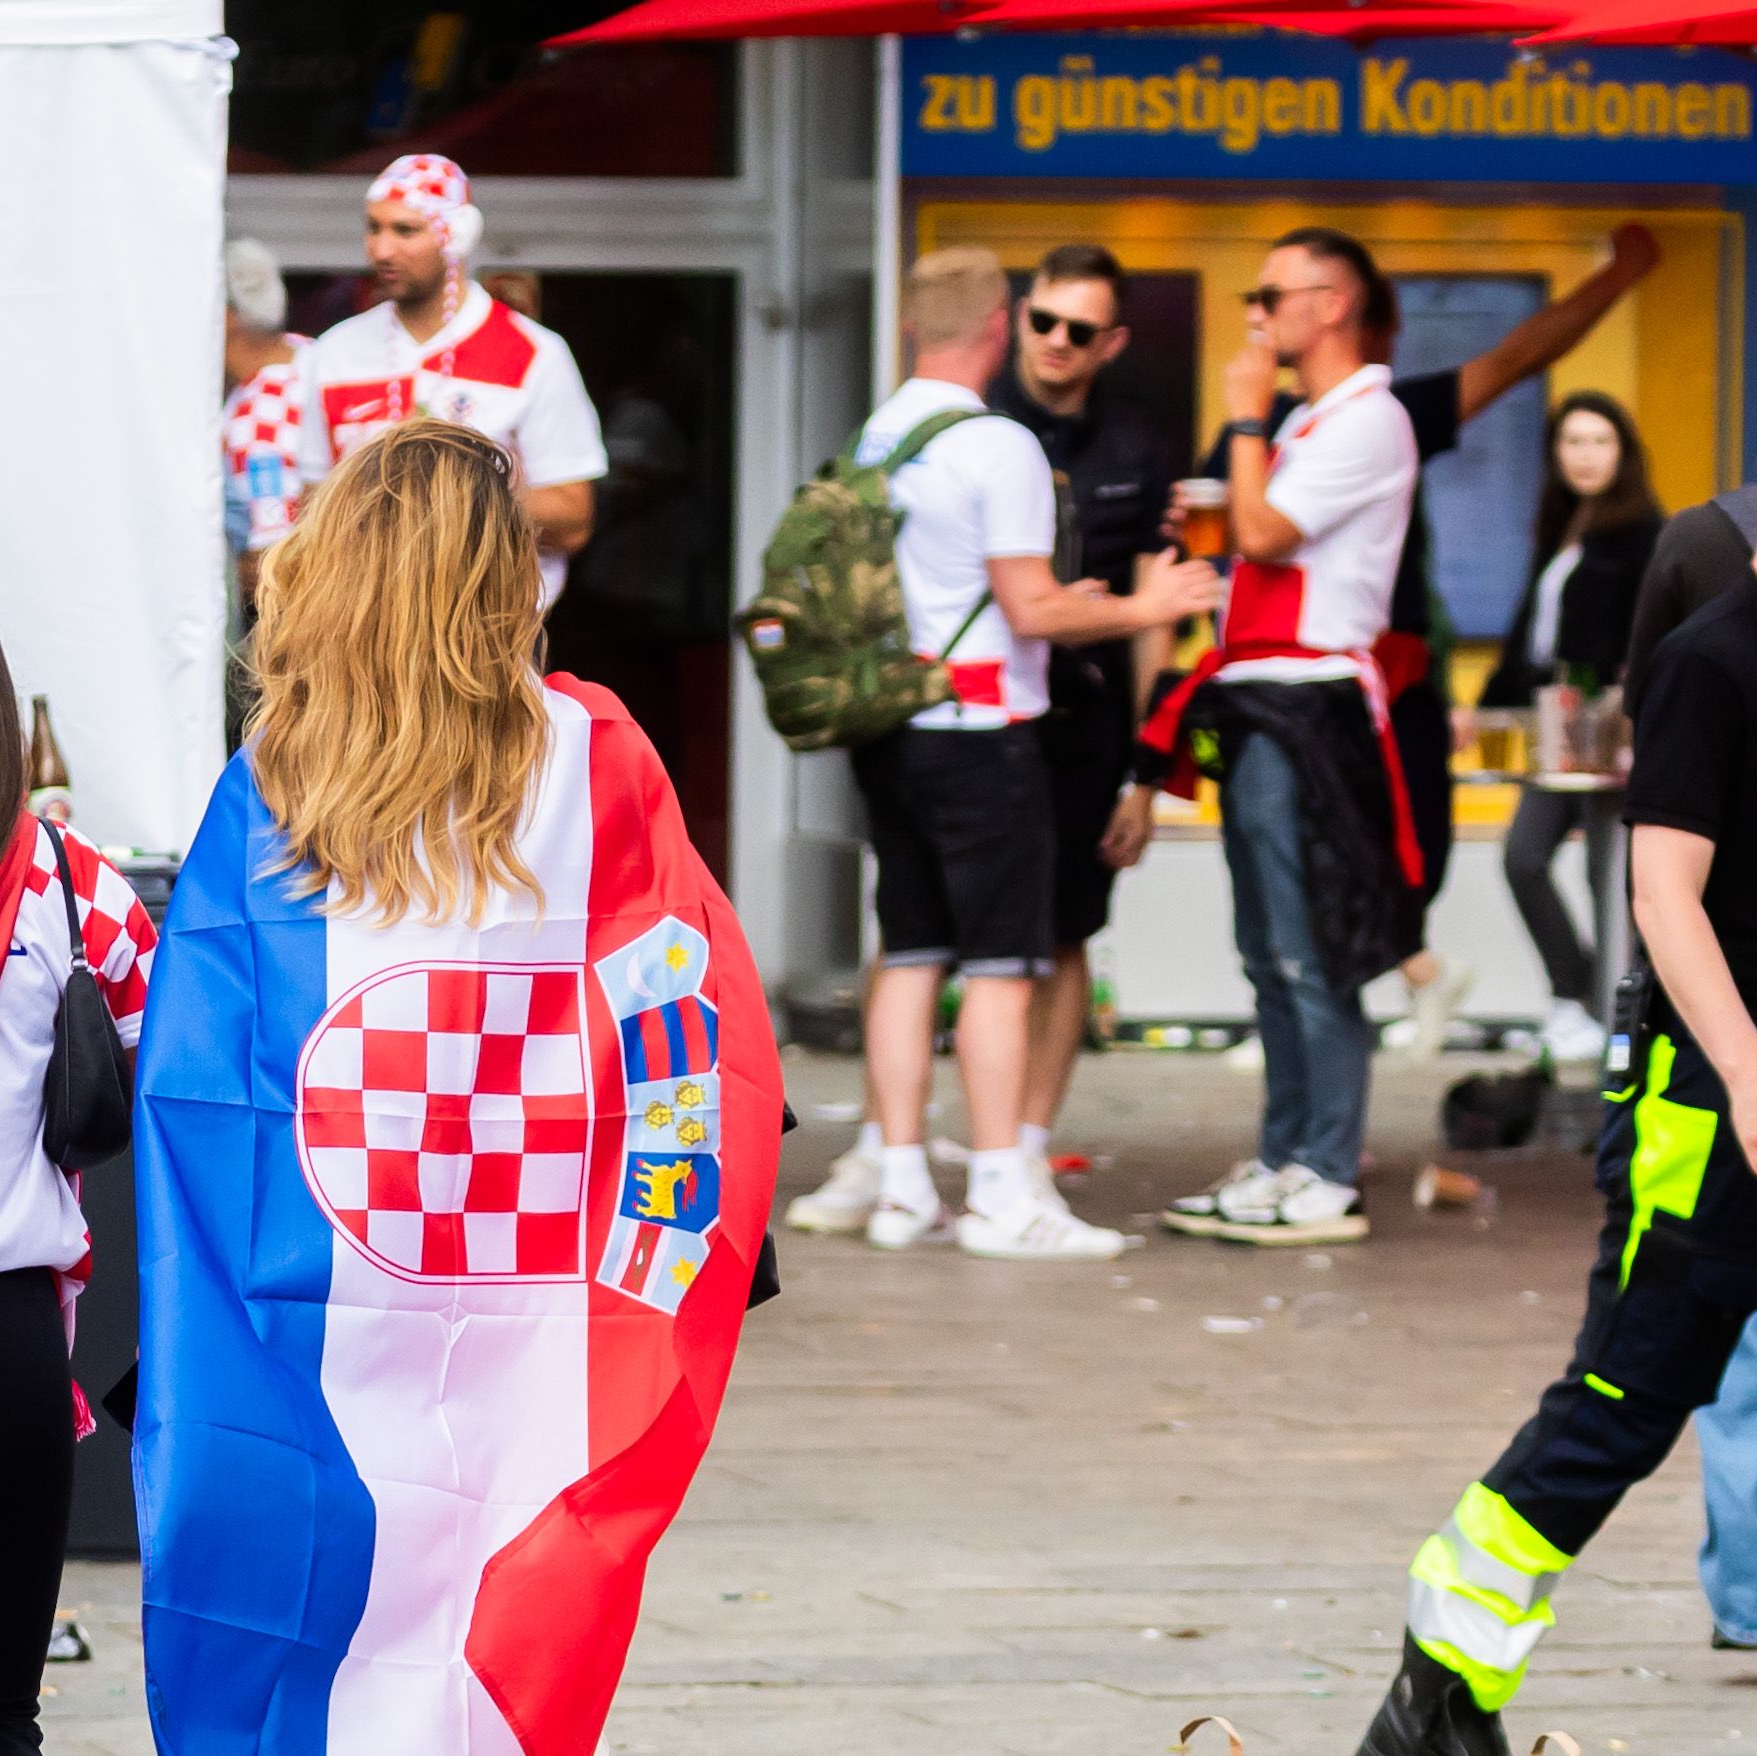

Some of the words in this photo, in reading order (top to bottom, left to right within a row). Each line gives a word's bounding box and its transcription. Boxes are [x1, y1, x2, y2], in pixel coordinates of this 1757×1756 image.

[919, 72, 997, 131] zu
[1016, 54, 1343, 153] günstigen
[1361, 56, 1751, 140] Konditionen
